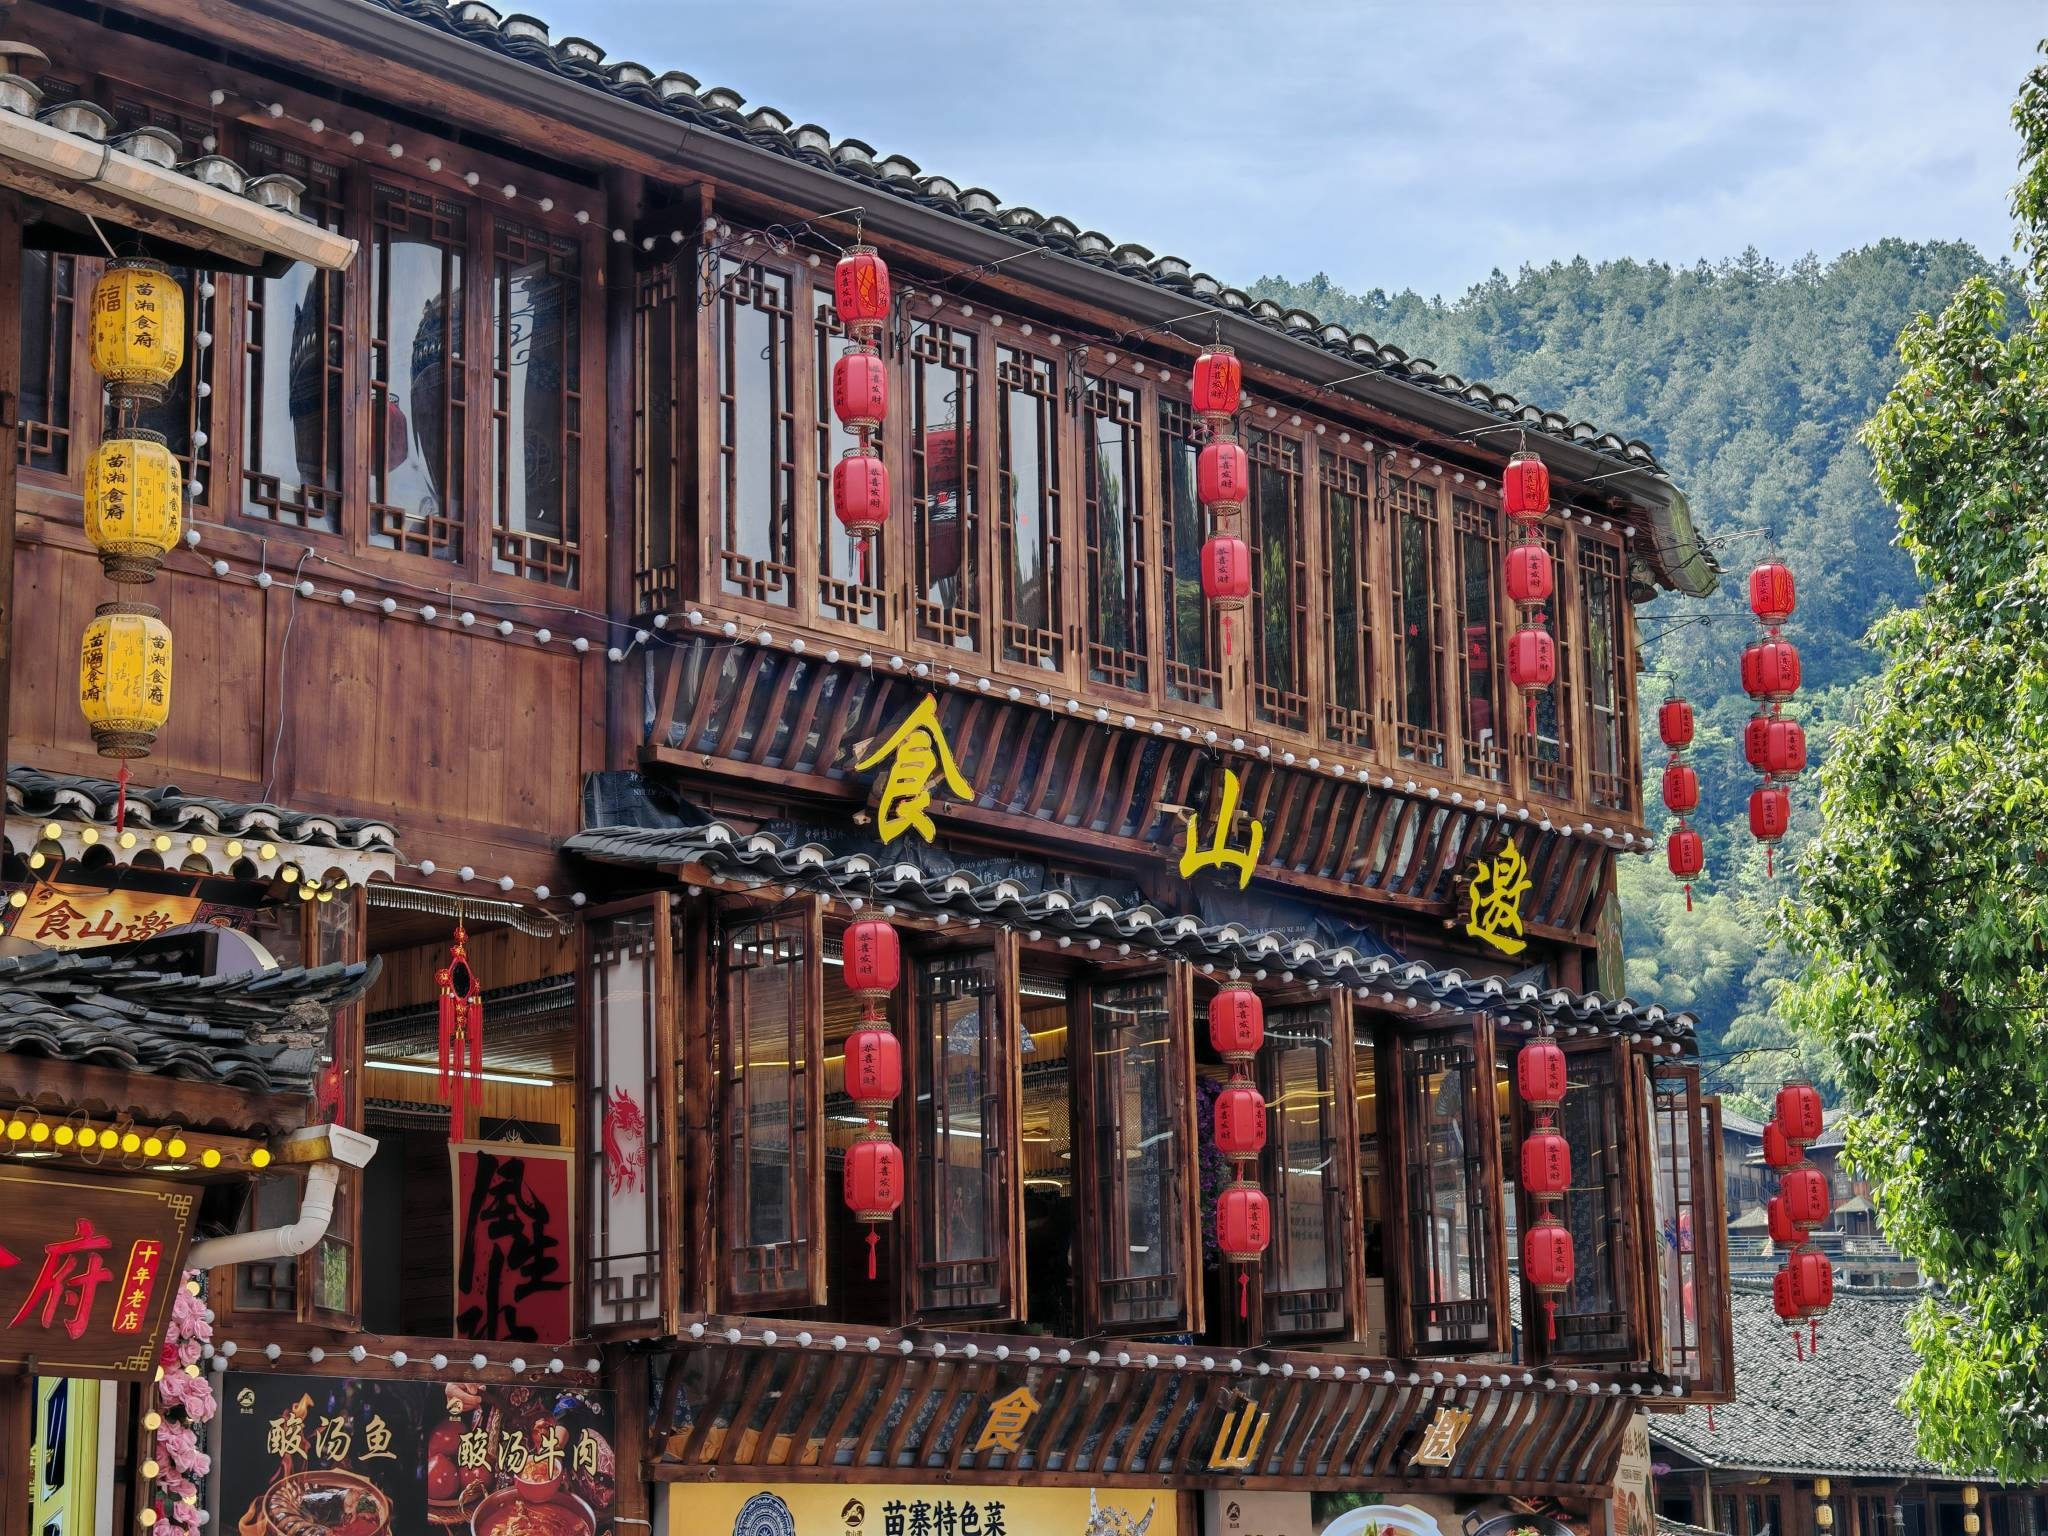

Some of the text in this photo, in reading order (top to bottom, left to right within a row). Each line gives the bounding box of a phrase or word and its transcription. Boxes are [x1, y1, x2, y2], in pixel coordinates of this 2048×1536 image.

[98, 284, 121, 314] 福
[131, 283, 159, 349] 苗湘食府
[1211, 362, 1225, 399] 恭喜发财
[101, 453, 129, 521] 苗湘食府
[869, 467, 882, 508] 恭喜发财
[1219, 453, 1233, 488] 恭喜发财
[1216, 547, 1230, 584] 恭喜发财
[1529, 555, 1541, 587] 恭喜发财
[147, 635, 169, 703] 苗湘食府
[1538, 638, 1549, 672] 恭喜发财
[31, 899, 174, 942] 食山邀
[858, 932, 873, 974] 恭喜发财
[1236, 1000, 1251, 1038] 恭喜发财
[861, 1043, 877, 1084] 恭喜发财
[879, 1155, 893, 1198] 恭喜发财
[1248, 1202, 1261, 1241] 恭喜发财
[0, 1216, 114, 1340] 府
[118, 1245, 158, 1331] 十年老店
[266, 1412, 398, 1461] 酸汤鱼
[457, 1426, 599, 1478] 酸汤牛肉
[881, 1499, 1008, 1536] 苗寨特色菜
